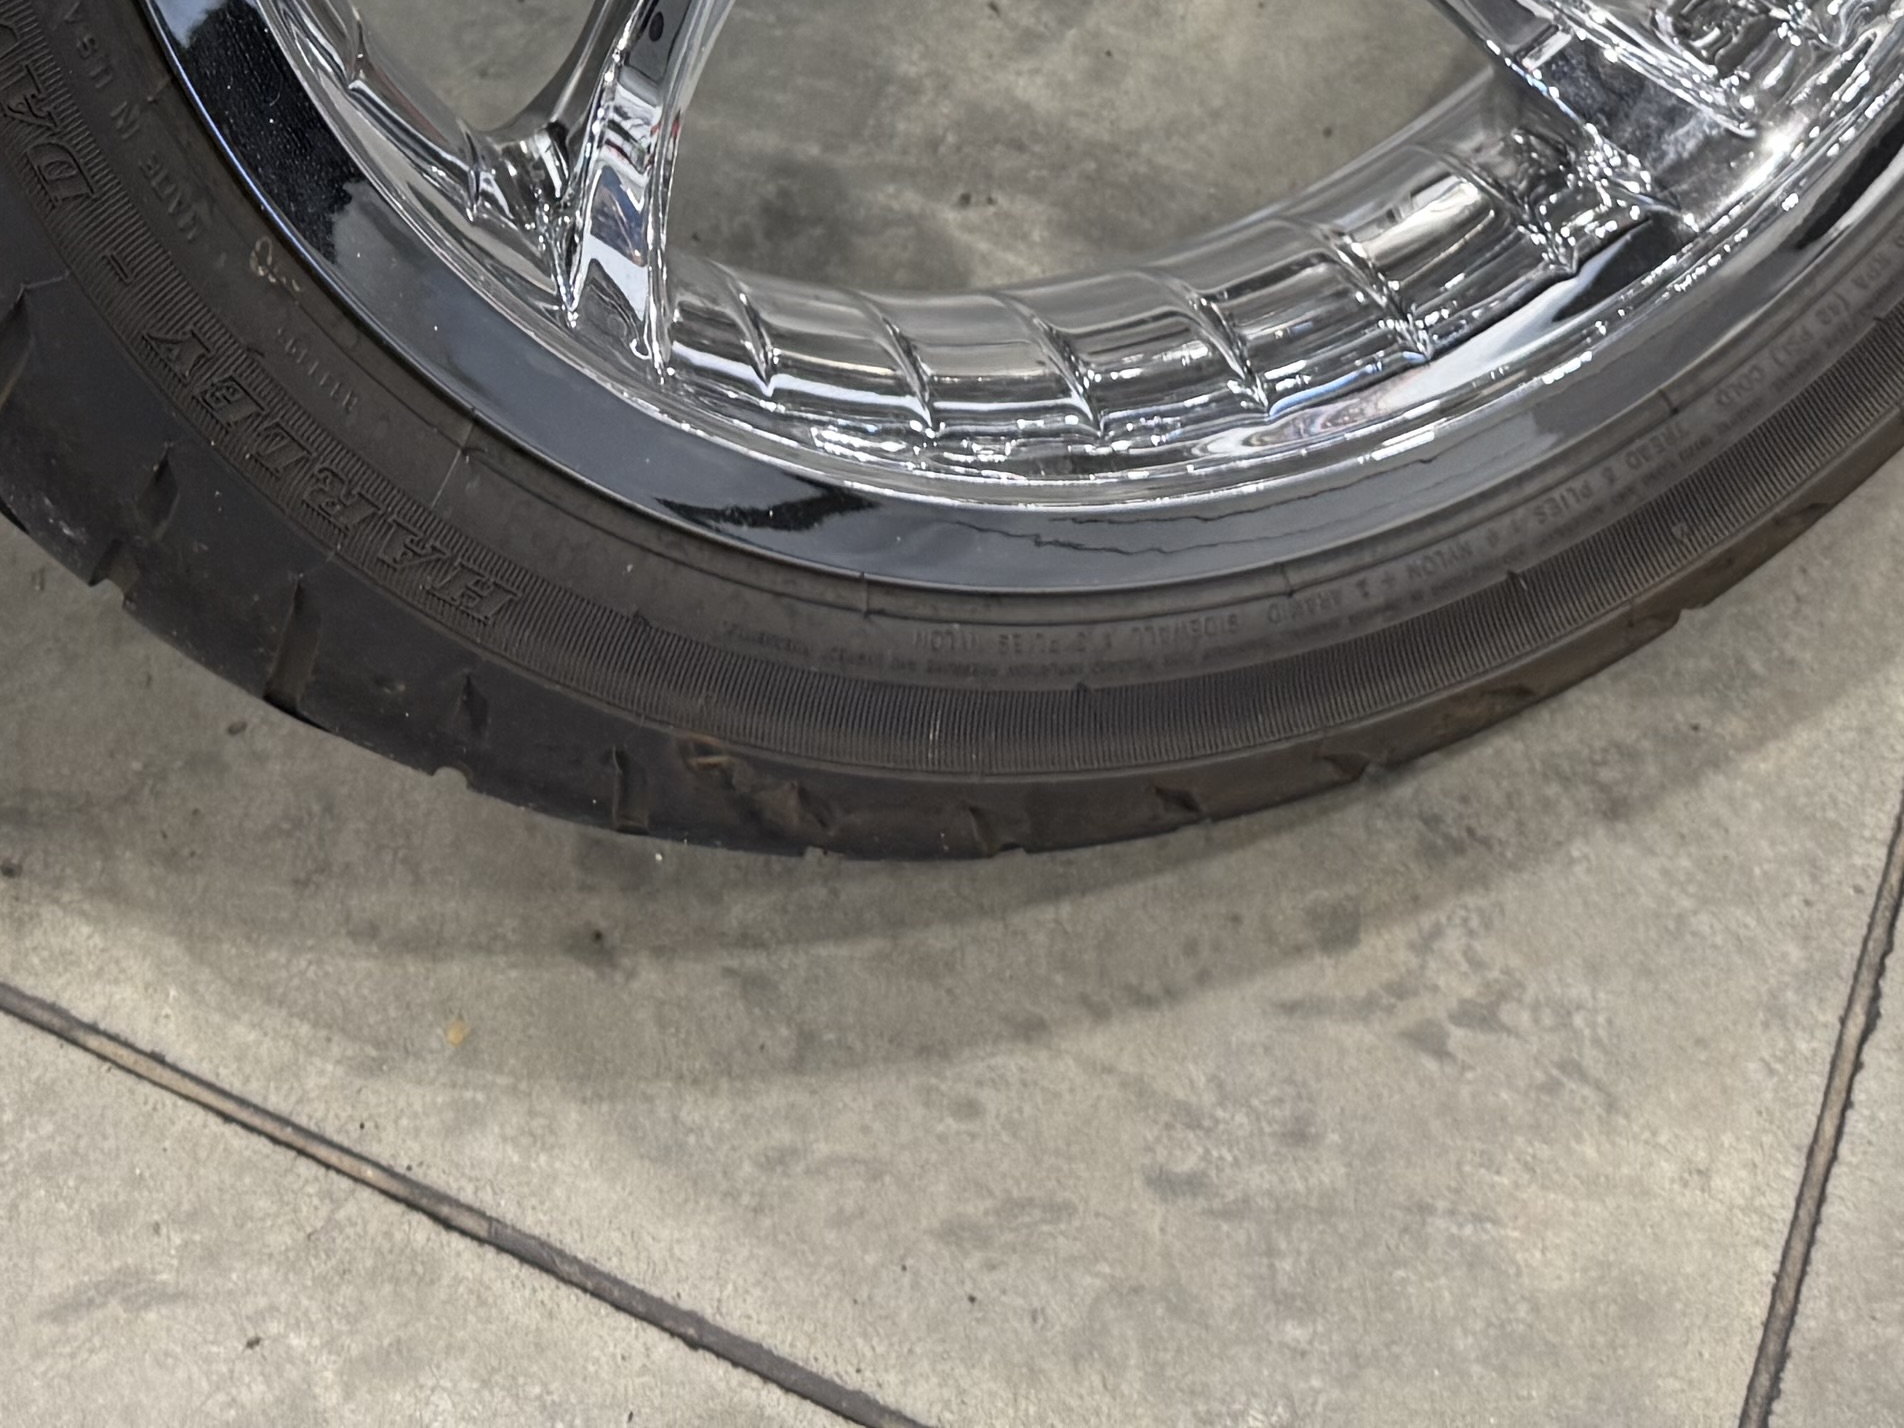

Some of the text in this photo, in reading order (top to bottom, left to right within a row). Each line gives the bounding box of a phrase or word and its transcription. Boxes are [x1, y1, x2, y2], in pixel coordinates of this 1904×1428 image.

[106, 97, 142, 142] IN
[134, 148, 207, 246] MADE
[1711, 361, 1768, 415] COLD
[137, 304, 523, 634] HARLEY
[1622, 418, 1686, 473] TREAD
[1530, 476, 1595, 527] PLIES
[1402, 537, 1474, 584] NYLON
